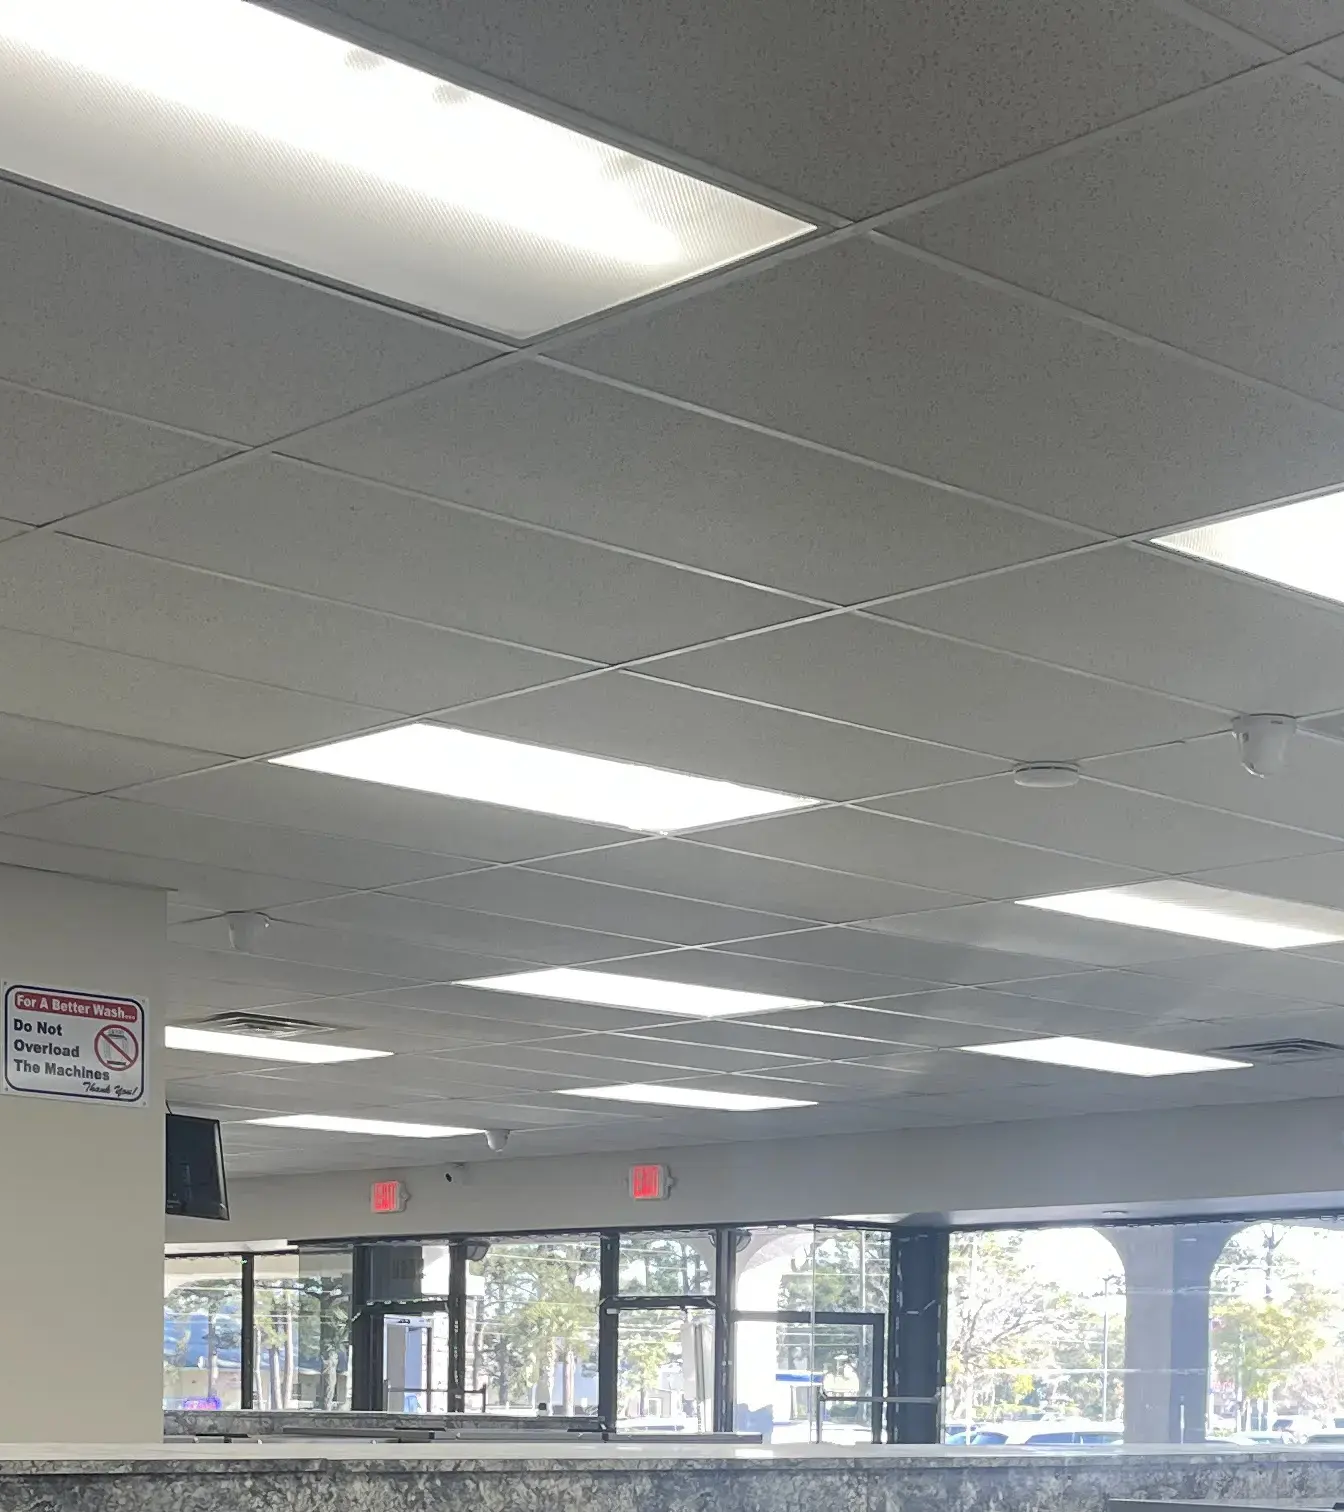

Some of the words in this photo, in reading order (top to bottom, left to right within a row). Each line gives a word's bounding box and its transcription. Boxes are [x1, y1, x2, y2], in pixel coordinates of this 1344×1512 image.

[16, 994, 37, 1007] For
[40, 998, 49, 1010] A
[52, 999, 91, 1015] Better
[14, 1018, 33, 1032] Do
[37, 1021, 63, 1036] Not
[14, 1039, 80, 1058] Overload
[14, 1059, 41, 1074] The
[44, 1062, 110, 1081] Machines
[82, 1082, 111, 1095] Thank
[113, 1085, 139, 1098] You!
